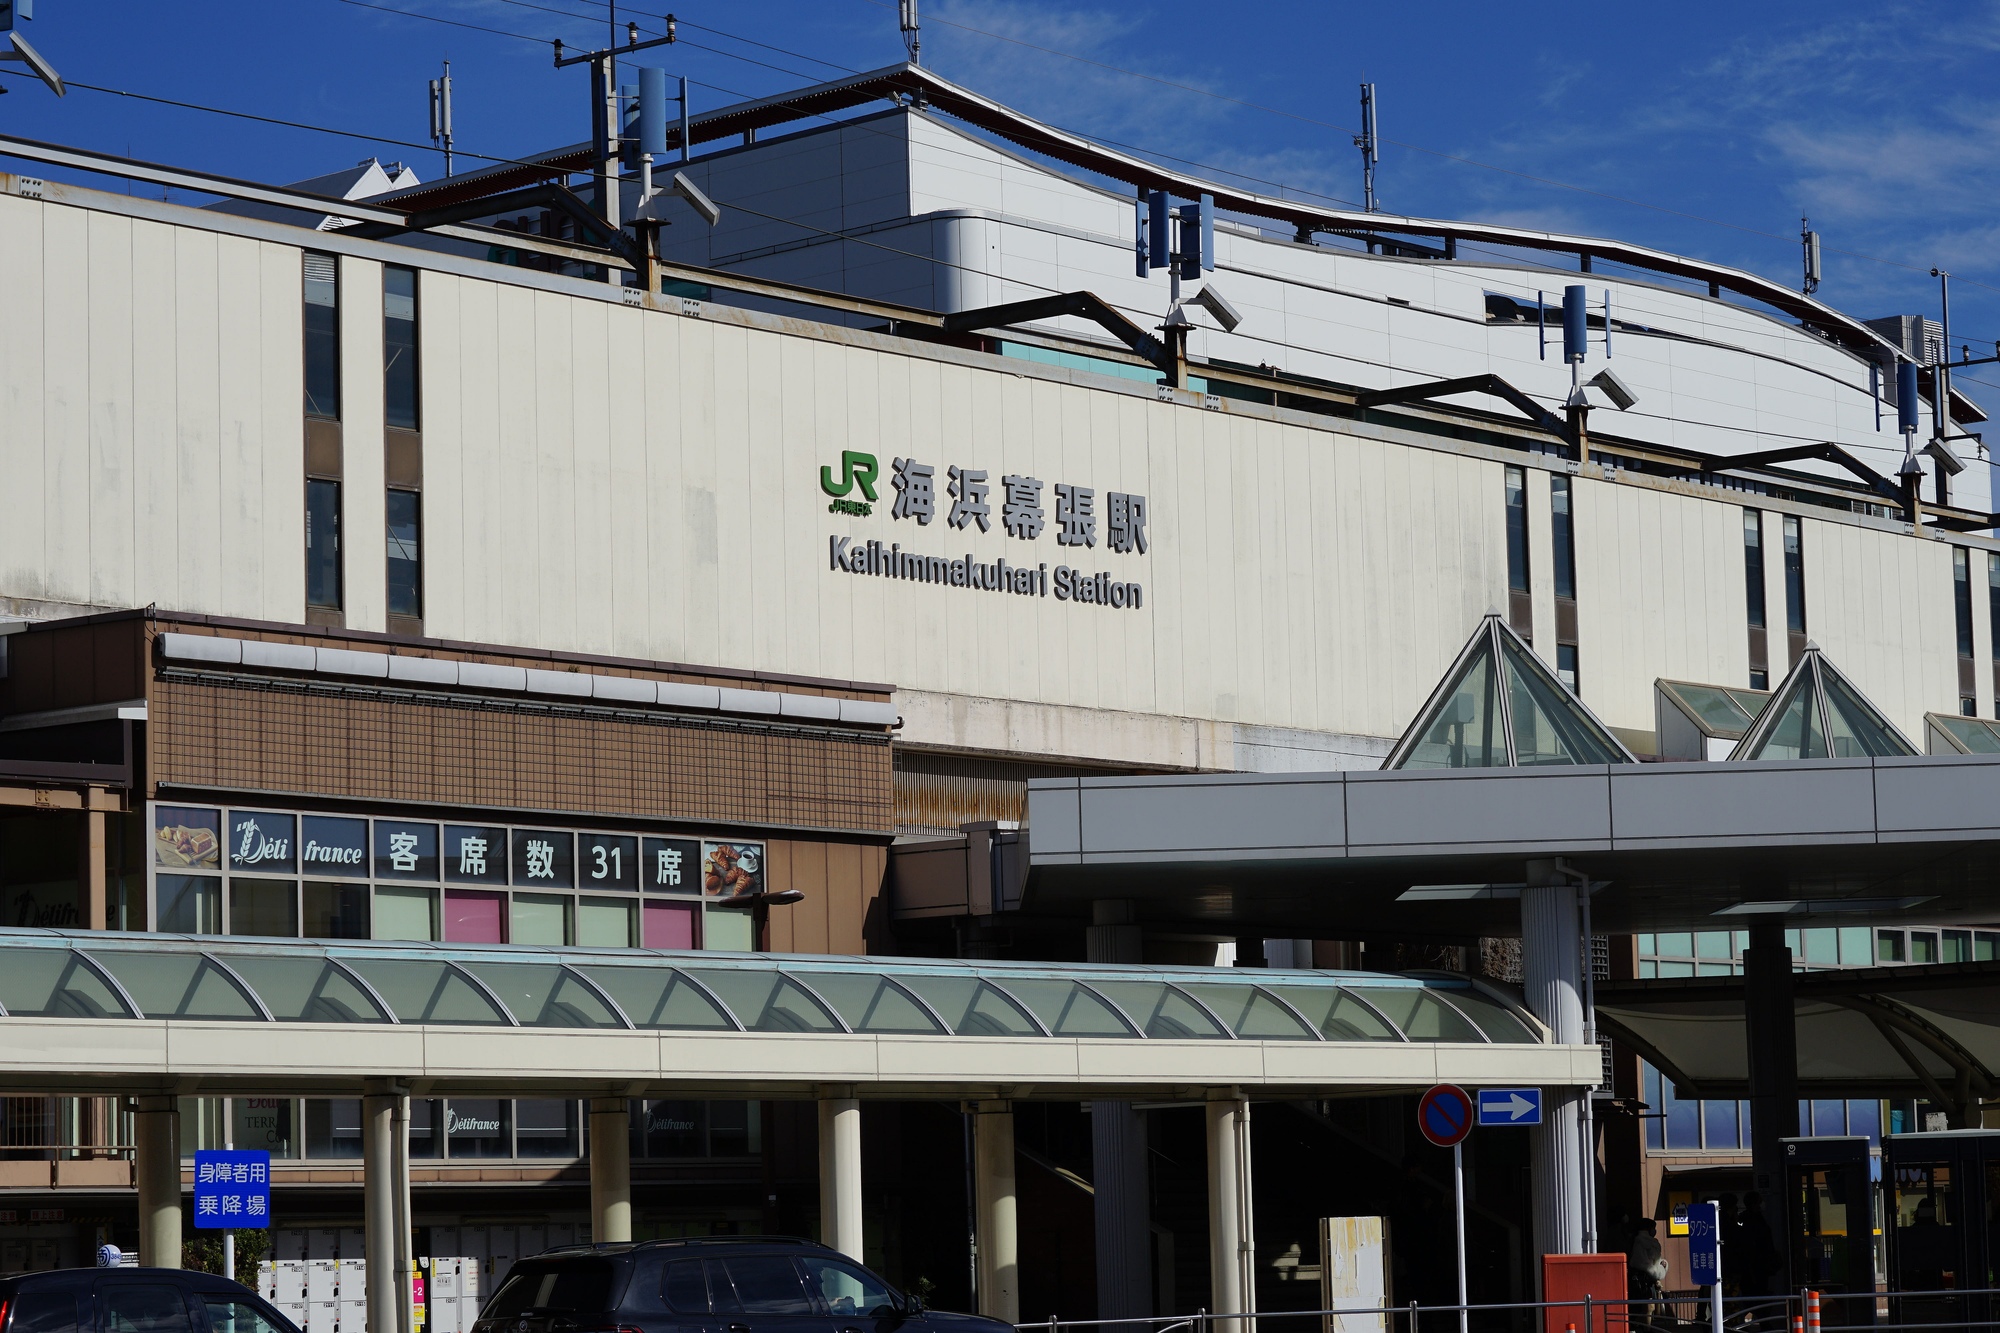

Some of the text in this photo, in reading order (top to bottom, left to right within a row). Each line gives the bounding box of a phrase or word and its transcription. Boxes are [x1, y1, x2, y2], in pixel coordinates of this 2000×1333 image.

[820, 450, 880, 502] JR
[828, 499, 873, 518] JR東日本
[891, 457, 1149, 556] 海浜幕張駅
[830, 534, 1144, 609] Kaihimmakuhari Station
[230, 818, 363, 866] Déli france
[446, 1107, 500, 1135] Délifrance
[646, 1108, 695, 1134] Délifrance
[198, 1162, 267, 1184] 身障者用
[198, 1195, 267, 1217] 乗降場
[1689, 1220, 1715, 1237] タクシー
